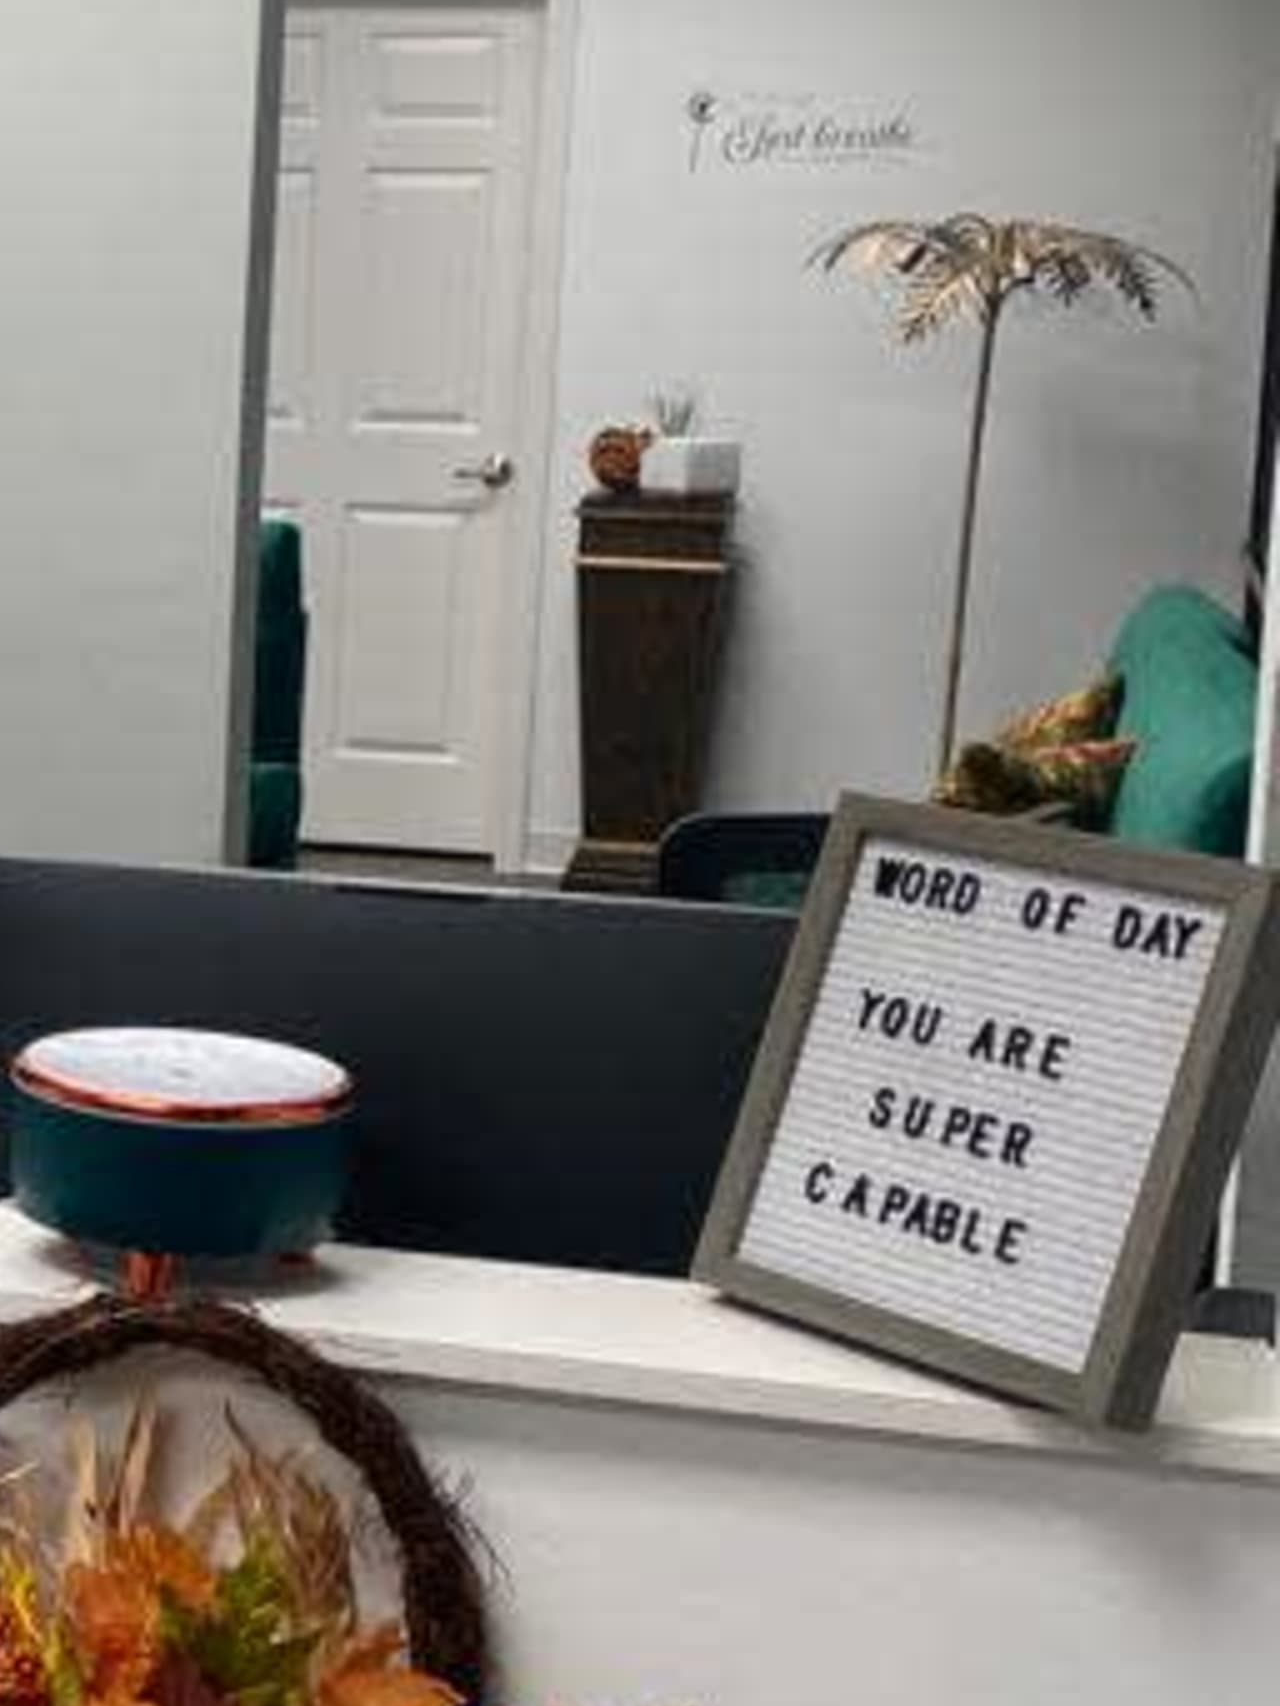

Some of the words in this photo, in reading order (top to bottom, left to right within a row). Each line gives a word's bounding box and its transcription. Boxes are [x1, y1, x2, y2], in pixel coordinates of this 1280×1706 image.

[874, 857, 980, 915] WORD
[1022, 888, 1086, 935] OF
[1113, 906, 1202, 960] DAY
[858, 989, 942, 1043] YOU
[968, 1021, 1071, 1081] ARE
[869, 1088, 1033, 1168] SUPER
[804, 1163, 1028, 1265] CAPABLE
